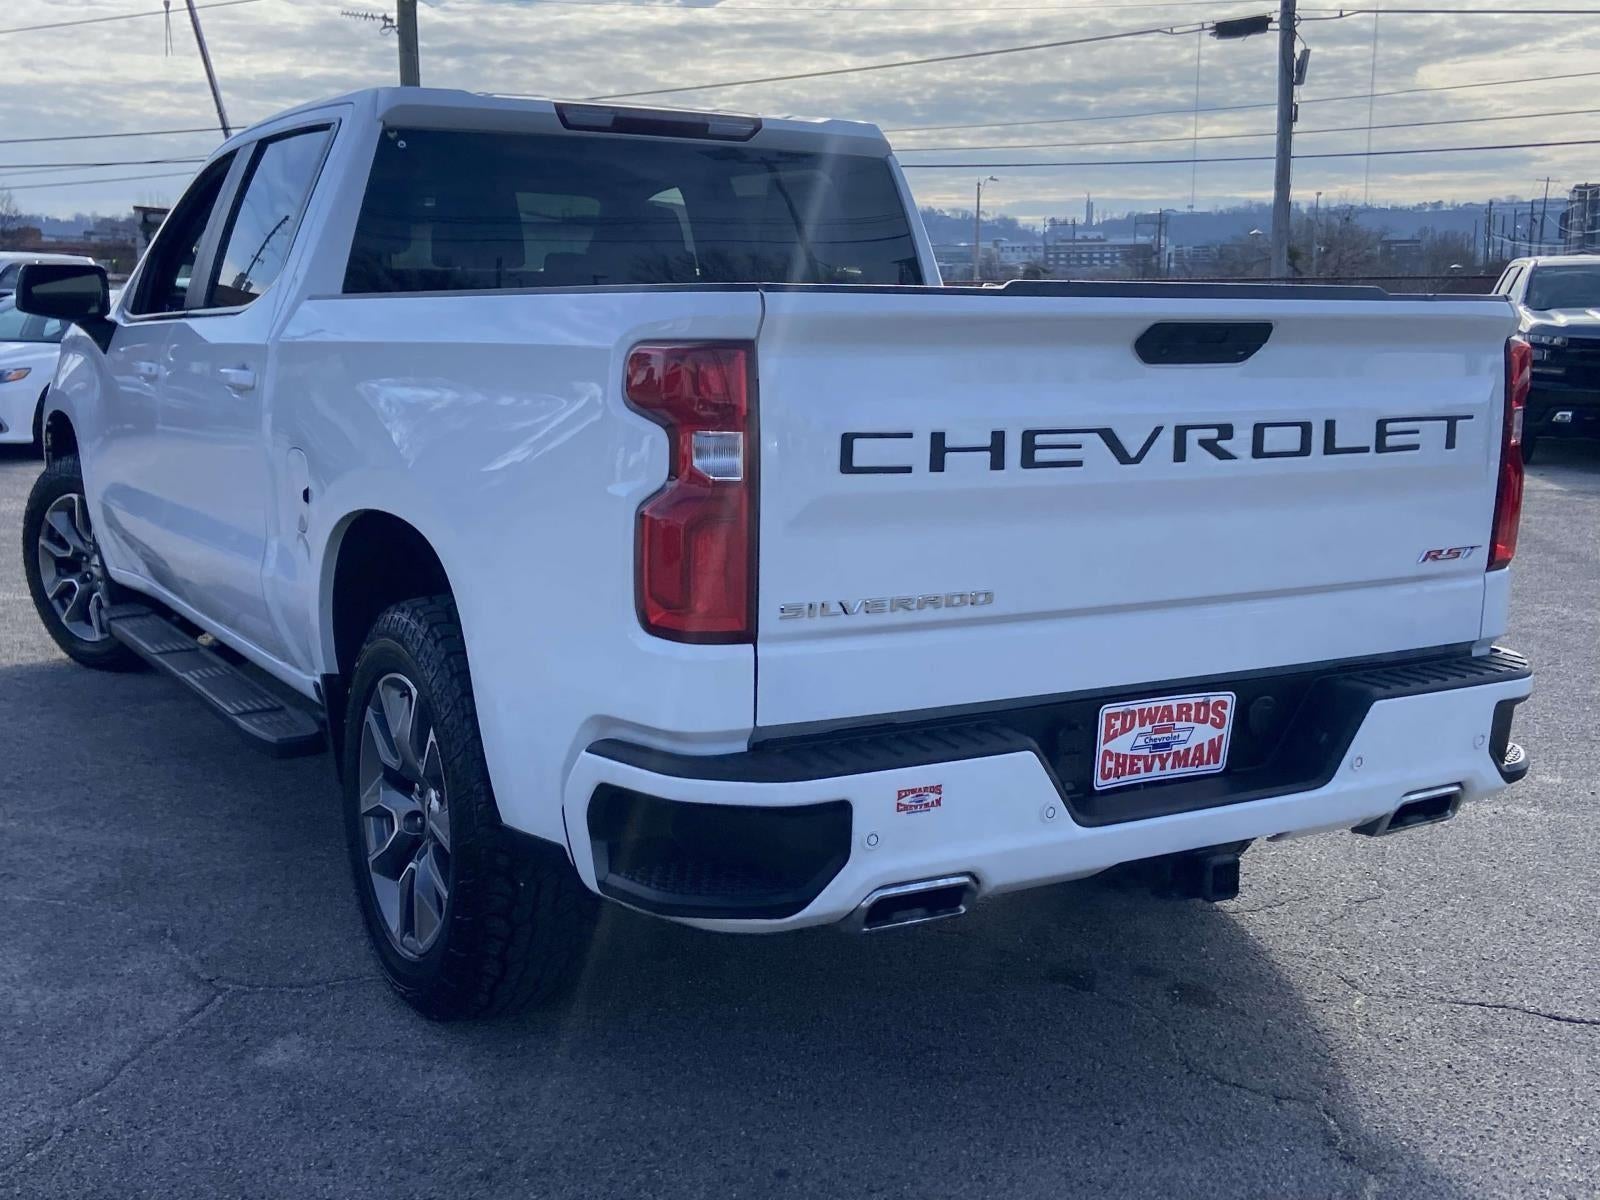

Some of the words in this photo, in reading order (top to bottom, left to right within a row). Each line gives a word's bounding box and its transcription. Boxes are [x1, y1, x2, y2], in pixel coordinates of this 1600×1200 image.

[840, 415, 1474, 474] CHEVROLET
[1417, 545, 1482, 563] RST
[779, 590, 994, 620] SILVERADO
[1103, 700, 1228, 746] EDWARDS
[1144, 733, 1180, 744] Chevrolet
[1100, 734, 1224, 781] CHEVYMAN
[896, 797, 941, 812] CHEVYMAN
[897, 784, 942, 801] EDWARDS
